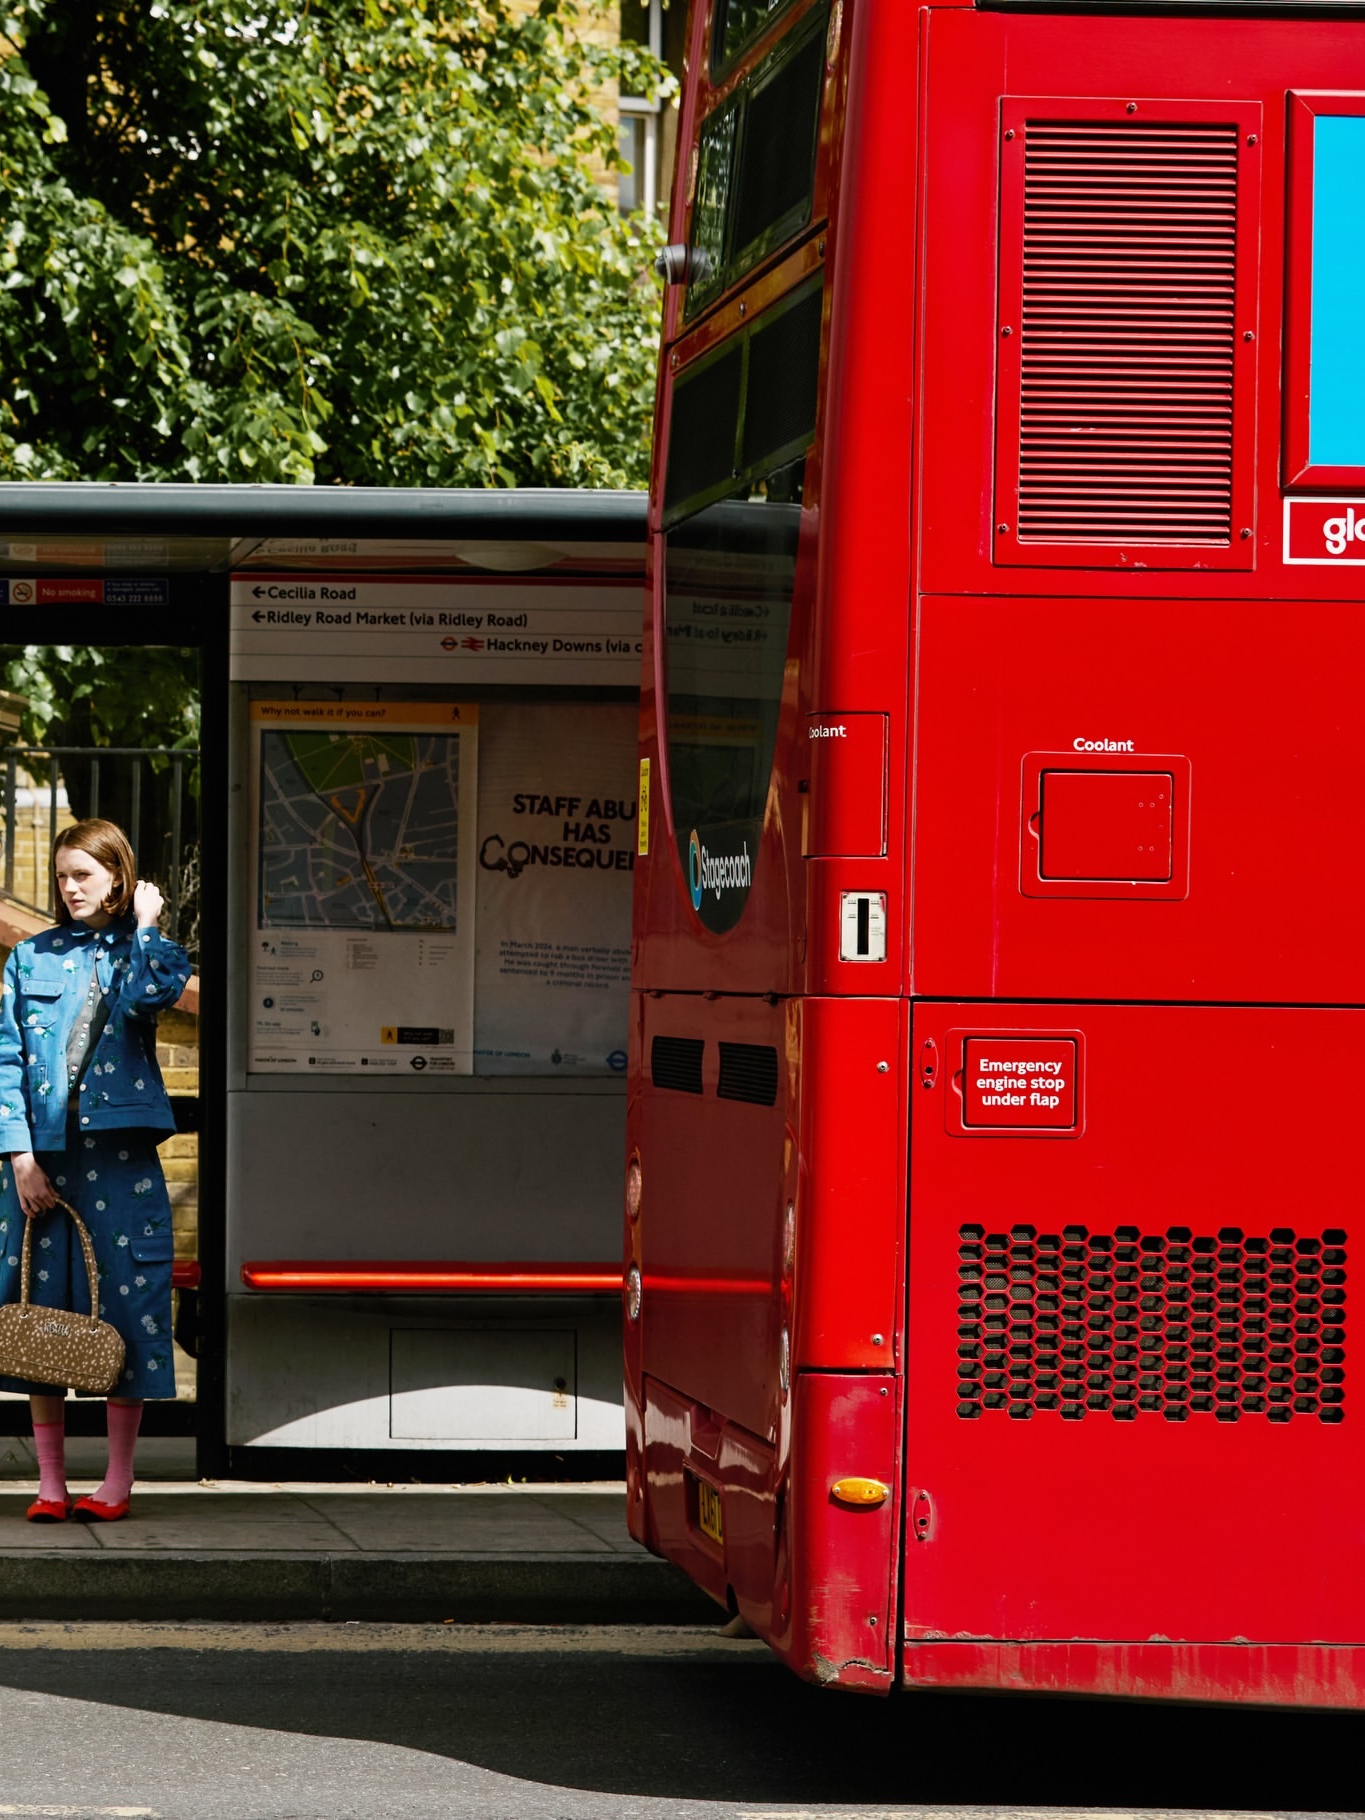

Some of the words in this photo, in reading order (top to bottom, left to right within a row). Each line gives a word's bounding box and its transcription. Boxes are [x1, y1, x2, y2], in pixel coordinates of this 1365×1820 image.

[42, 587, 56, 597] No
[58, 587, 96, 599] smoking
[268, 586, 316, 600] Cecilia
[321, 587, 356, 600] Road
[268, 611, 311, 627] Ridley
[316, 612, 352, 625] Road
[356, 612, 406, 625] Market
[410, 612, 434, 626] (via
[438, 613, 483, 629] Ridley
[487, 614, 528, 628] Road)
[487, 638, 548, 654] Hackney
[553, 639, 602, 653] Downs
[606, 639, 630, 654] (via
[261, 706, 282, 718] Why
[285, 707, 300, 716] not
[303, 706, 325, 717] walk
[327, 707, 334, 717] it
[337, 707, 343, 717] if
[345, 709, 363, 719] you
[365, 708, 386, 718] can?
[1073, 737, 1134, 753] Coolant
[513, 794, 581, 817] STAFF
[586, 798, 636, 821] ABU
[563, 821, 611, 844] HAS
[701, 840, 752, 901] Stagecoach
[979, 1058, 1062, 1075] Emergency
[976, 1075, 1027, 1091] engine
[1030, 1075, 1065, 1091] stop
[981, 1093, 1027, 1107] under
[1030, 1092, 1059, 1109] flap
